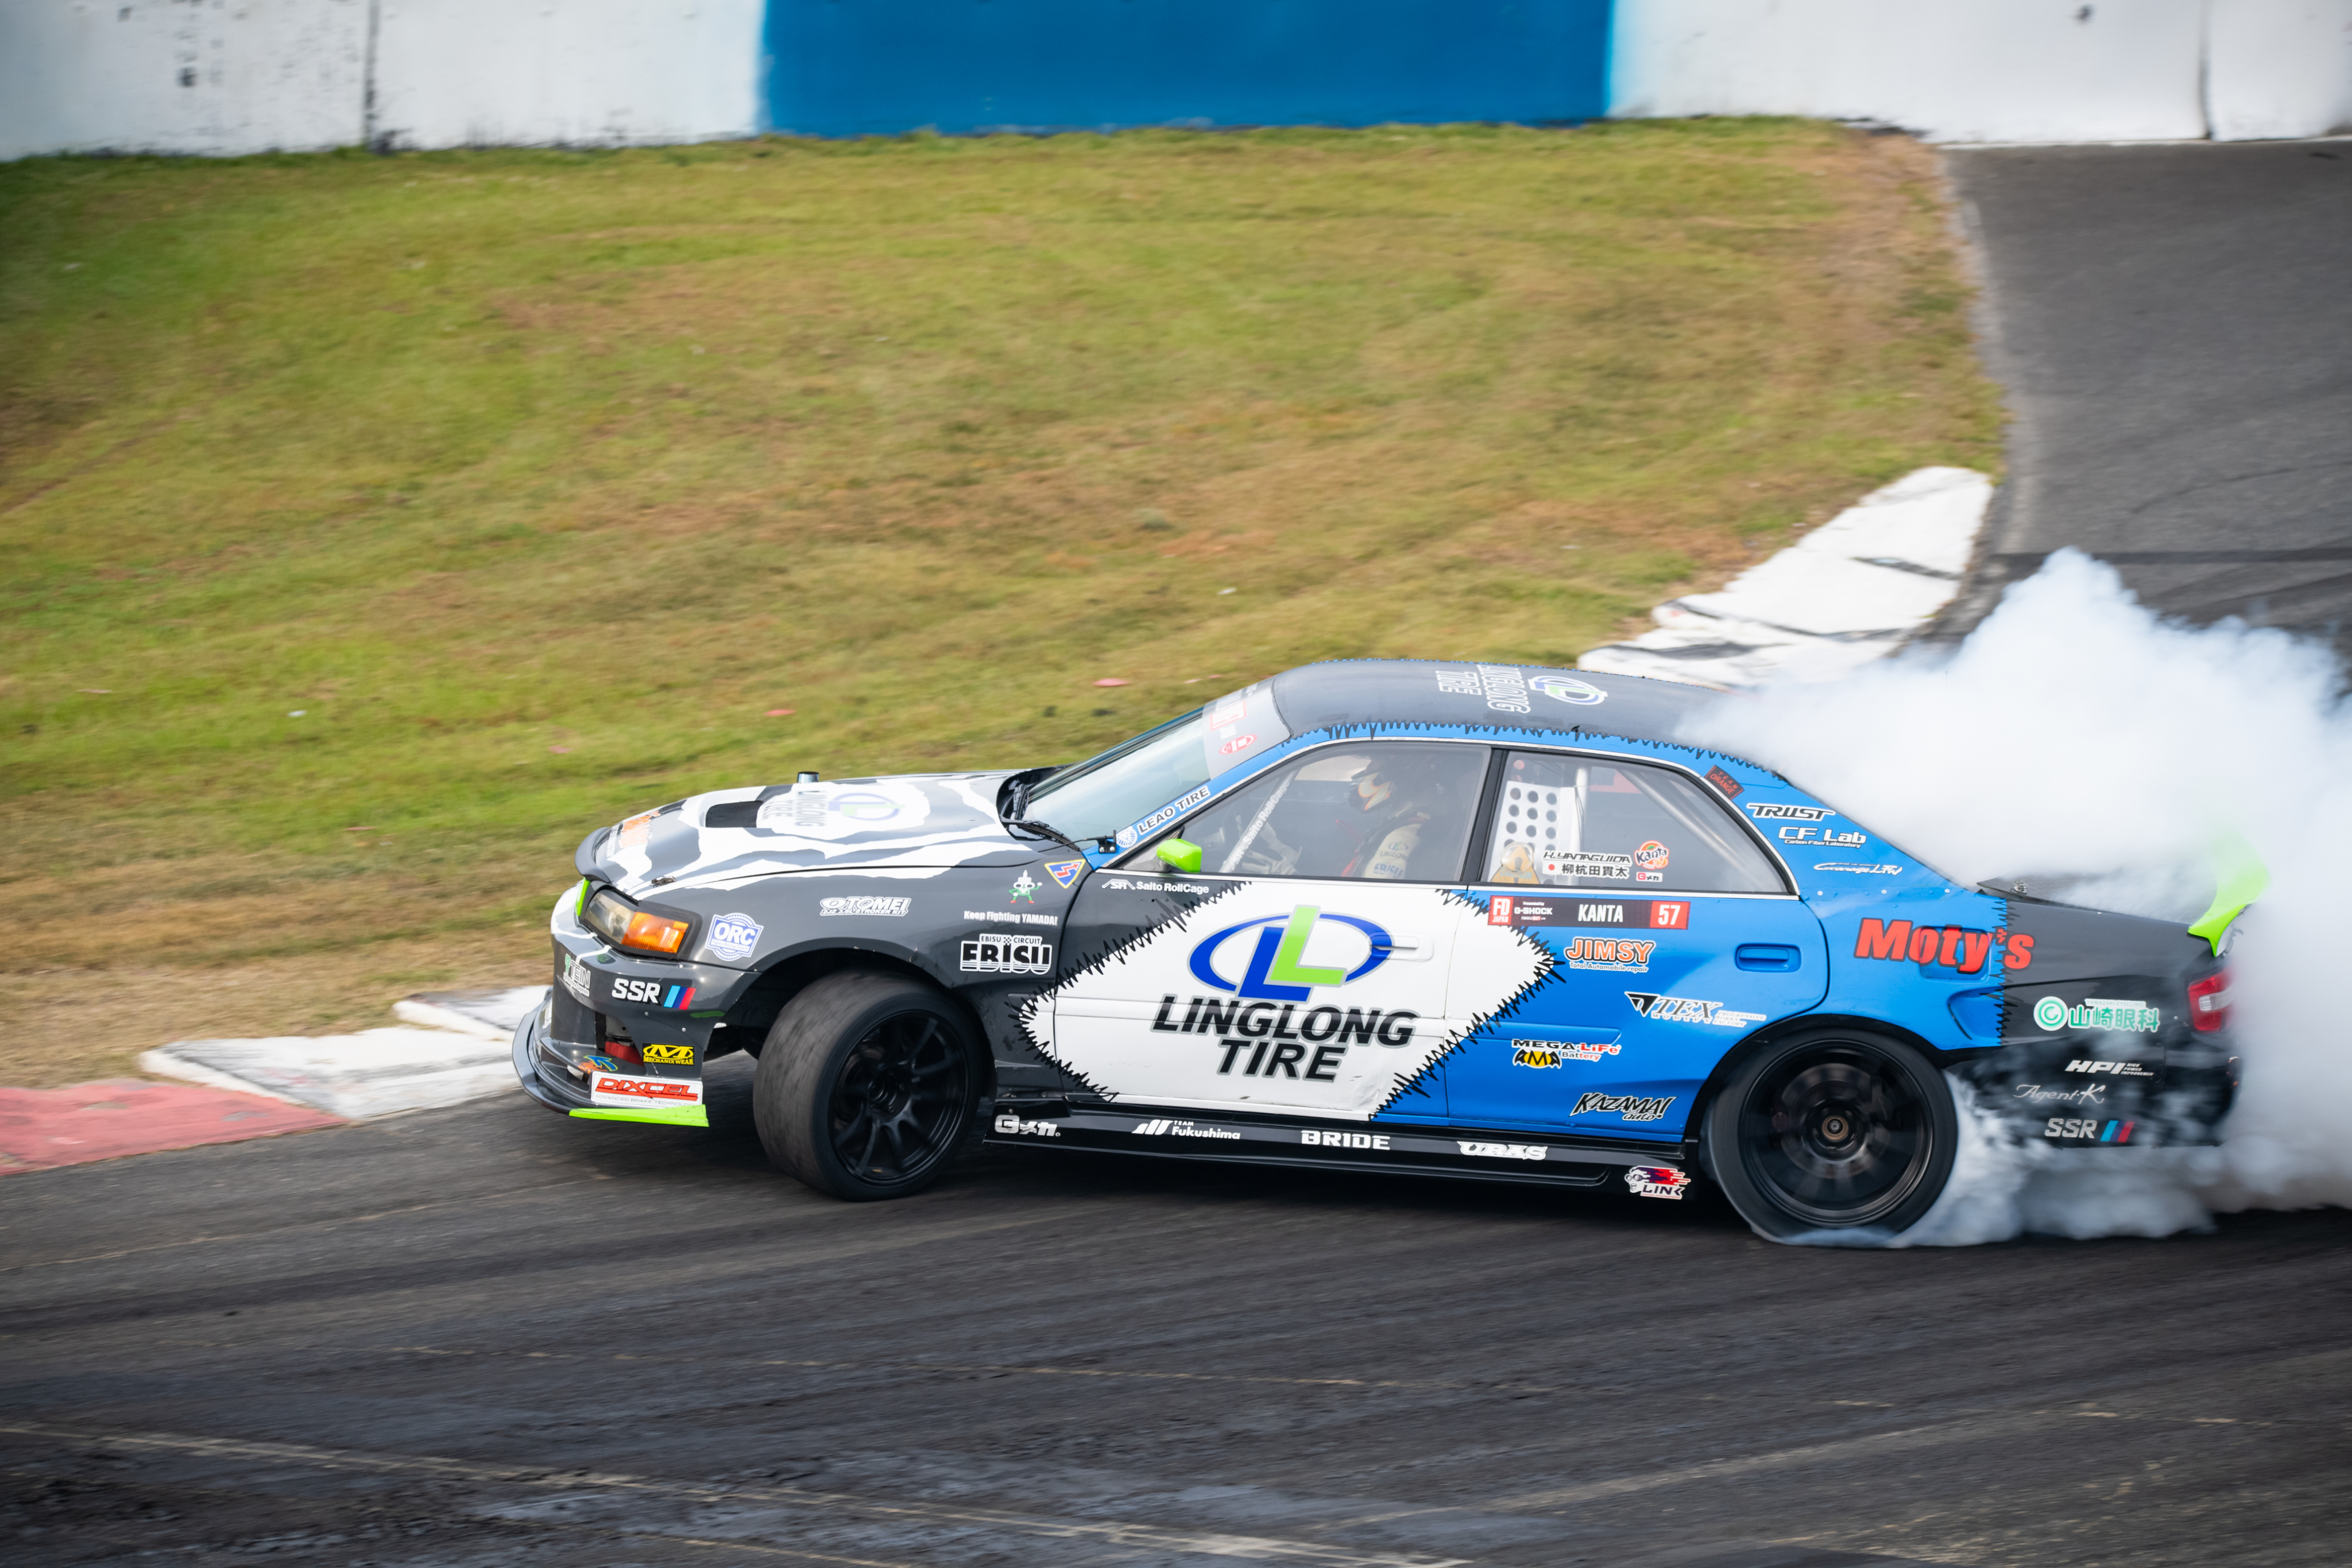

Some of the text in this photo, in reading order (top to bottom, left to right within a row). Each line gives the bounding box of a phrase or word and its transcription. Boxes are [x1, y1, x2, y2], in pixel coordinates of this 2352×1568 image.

[1435, 670, 1483, 696] TIRE
[1709, 773, 1735, 795] ORANGE
[1718, 772, 1739, 789] TEAM
[1138, 787, 1209, 834] LEAO TIRE
[1242, 820, 1264, 846] Saito
[1258, 779, 1291, 822] RollCage
[1747, 804, 1836, 820] TRUST
[1778, 826, 1867, 844] CF Lab
[1825, 841, 1862, 849] Laboratory
[1636, 847, 1668, 865] Kanta
[1136, 881, 1162, 891] Saito
[1163, 882, 1210, 895] RollCage
[1493, 897, 1511, 916] FD
[1514, 907, 1553, 915] G-SHOCK
[1577, 904, 1624, 923] KANTA
[1657, 904, 1681, 926] 57
[964, 911, 1059, 926] Keep Fighting YAMADA!
[714, 922, 756, 946] ORC
[1565, 937, 1655, 965] JIMSY
[1854, 917, 2036, 974] Moty's
[961, 942, 1052, 974] EBISU
[1587, 963, 1626, 971] Automobile
[612, 978, 661, 1004] SSR
[1152, 995, 1420, 1046] LINGLONG
[1651, 1013, 1711, 1024] MODIFY
[1718, 1011, 1766, 1020] PROGRESSIVE
[2069, 1005, 2159, 1031] 山崎眼科
[643, 1055, 694, 1066] MECHANIX WEAR
[1218, 1038, 1347, 1082] TIRE
[1562, 1051, 1600, 1061] Battery
[2064, 1059, 2126, 1075] HPI
[595, 1077, 699, 1101] DIXCEL
[1622, 1113, 1657, 1122] auto
[1171, 1126, 1241, 1140] Fukushima
[2044, 1117, 2098, 1139] SSR
[1301, 1130, 1390, 1151] BRIDE
[1456, 1141, 1548, 1161] URAS
[1642, 1184, 1683, 1196] LINK
